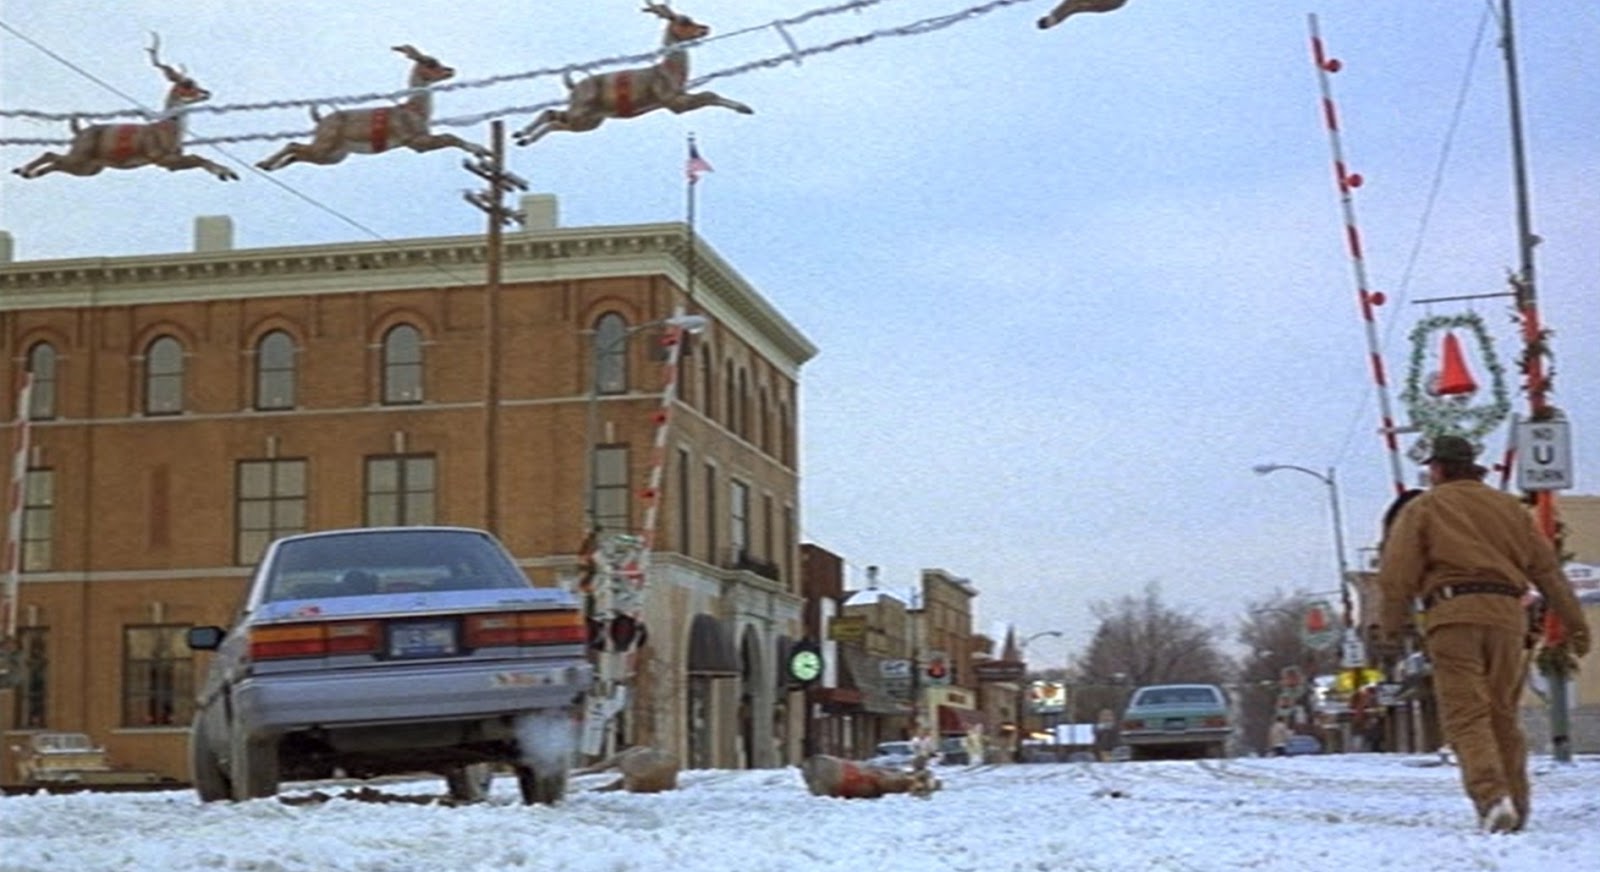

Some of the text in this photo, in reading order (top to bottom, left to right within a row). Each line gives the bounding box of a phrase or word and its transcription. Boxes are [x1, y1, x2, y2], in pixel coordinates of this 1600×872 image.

[1532, 428, 1553, 441] NO
[1532, 445, 1554, 465] U
[1526, 469, 1564, 481] TURN
